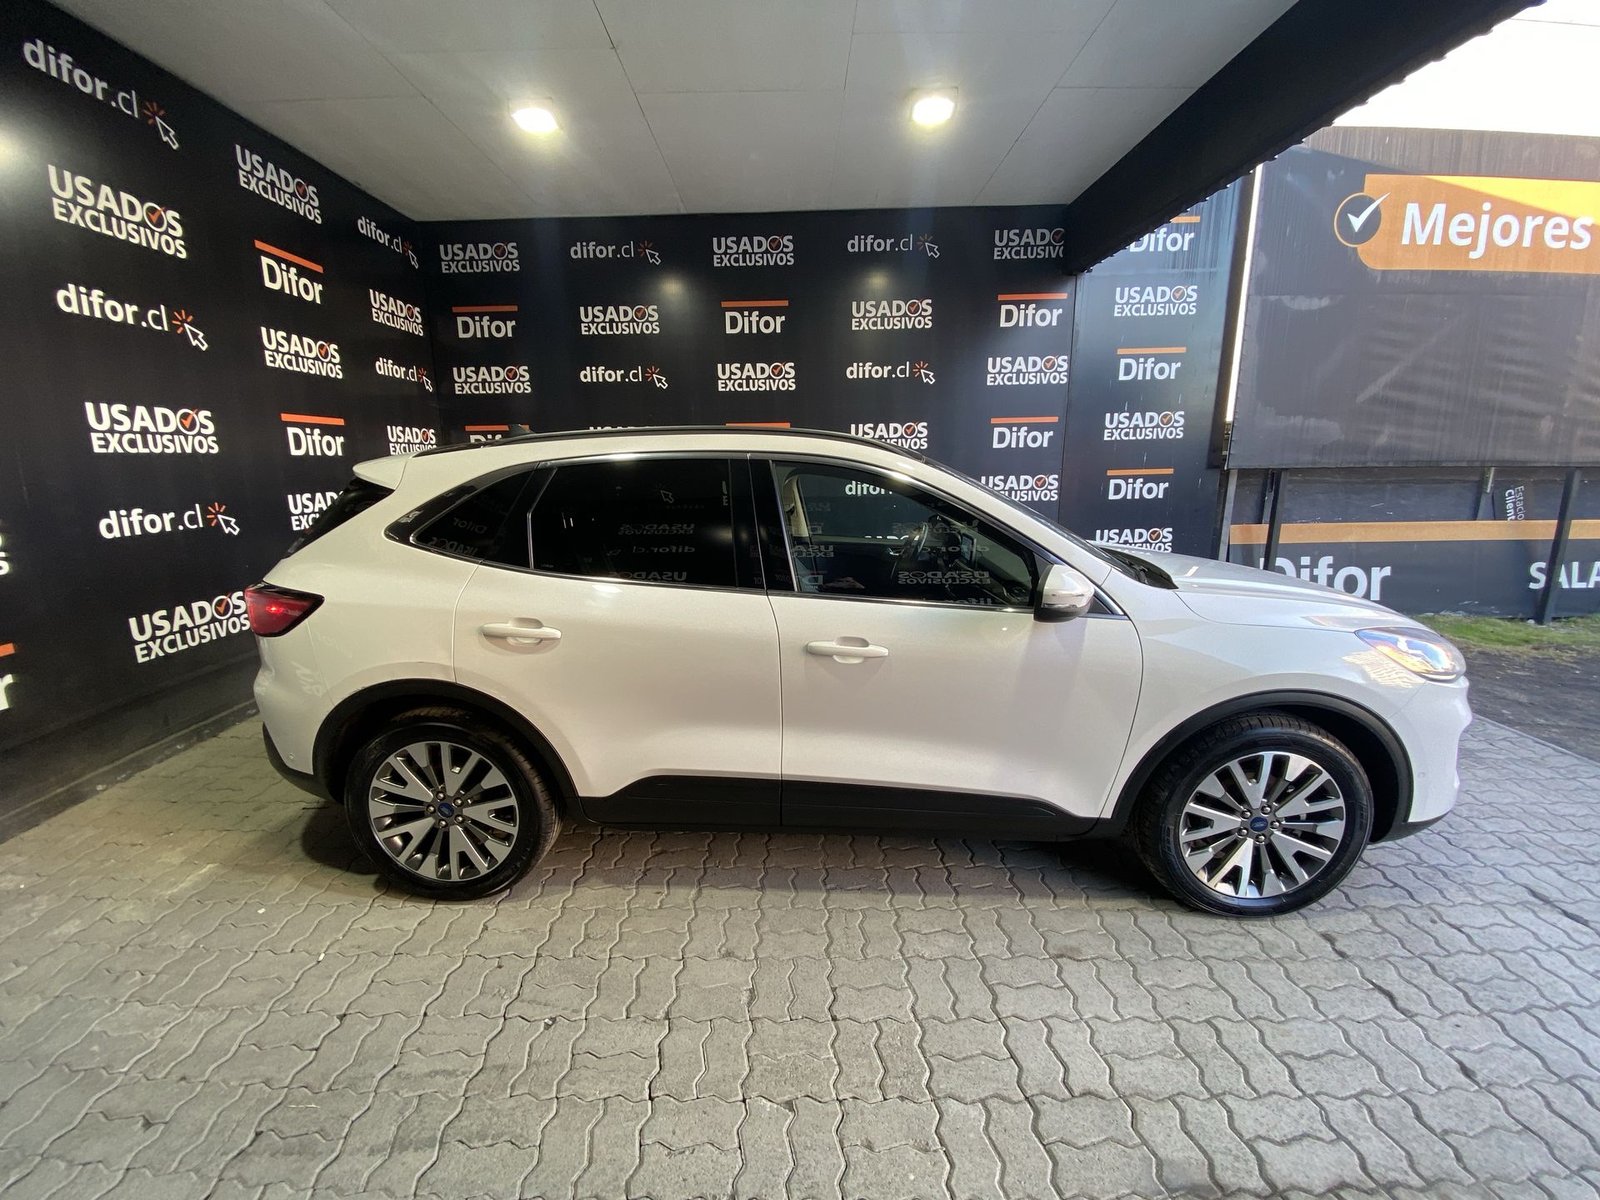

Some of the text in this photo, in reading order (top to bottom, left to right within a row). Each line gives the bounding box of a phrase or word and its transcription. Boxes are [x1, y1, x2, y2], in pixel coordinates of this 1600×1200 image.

[23, 38, 138, 118] difor.cl
[235, 144, 319, 207] USADOS
[48, 165, 183, 237] USADOS
[238, 169, 322, 224] EXCLUSIVOS
[52, 197, 187, 259] EXCLUSIVOS
[357, 216, 402, 252] difor.cl
[994, 228, 1065, 246] USADO
[1401, 201, 1592, 260] Mejores
[440, 242, 518, 261] USADOS
[570, 240, 634, 259] difor.cl
[712, 235, 794, 253] USADOS
[847, 234, 913, 253] difor.cl
[993, 246, 1064, 259] EXCLUSIV
[441, 259, 520, 274] EXCLUSIVOS
[713, 253, 794, 267] EXCLUSIVOS
[260, 256, 323, 304] Difor
[1115, 285, 1198, 303] USADOS
[57, 283, 169, 331] difor.cl
[369, 289, 421, 323] USADOS
[579, 305, 658, 322] USADOS
[851, 299, 932, 318] USADOS
[1000, 304, 1063, 327] Difor
[1114, 303, 1197, 317] EXCLUSIVOS
[372, 308, 424, 336] EXCLUSIVOS
[457, 315, 516, 339] Difor
[581, 321, 660, 335] EXCLUSIVOS
[725, 311, 785, 334] Difor
[851, 315, 932, 331] EXCLUSIVOS
[260, 326, 341, 364] USADOS
[264, 350, 343, 379] EXCLUSIVOS
[375, 357, 418, 382] difor.cl
[453, 365, 529, 382] USADOS
[579, 365, 642, 383] difor.cl
[717, 362, 795, 380] USADOS
[846, 361, 910, 379] difor.cl
[987, 355, 1068, 374] USADOS
[1118, 358, 1181, 381] Difor
[717, 378, 796, 392] EXCLUSIVOS
[986, 370, 1068, 386] EXCLUSIVOS
[454, 381, 531, 395] EXCLUSIVOS
[85, 402, 215, 434] USADOS
[1105, 410, 1185, 429] USADOS
[387, 425, 436, 444] USADOS
[850, 423, 928, 438] USADOS
[992, 427, 1053, 449] Difor
[1103, 425, 1184, 441] EXCLUSIVOS
[91, 432, 219, 454] EXCLUSIVOS
[286, 426, 345, 457] Difor
[1108, 478, 1169, 500] Difor
[99, 503, 204, 539] difor.cl
[1095, 528, 1173, 543] USADOS
[128, 591, 247, 642] USADOS
[134, 613, 250, 664] EXCLUSIVOS
